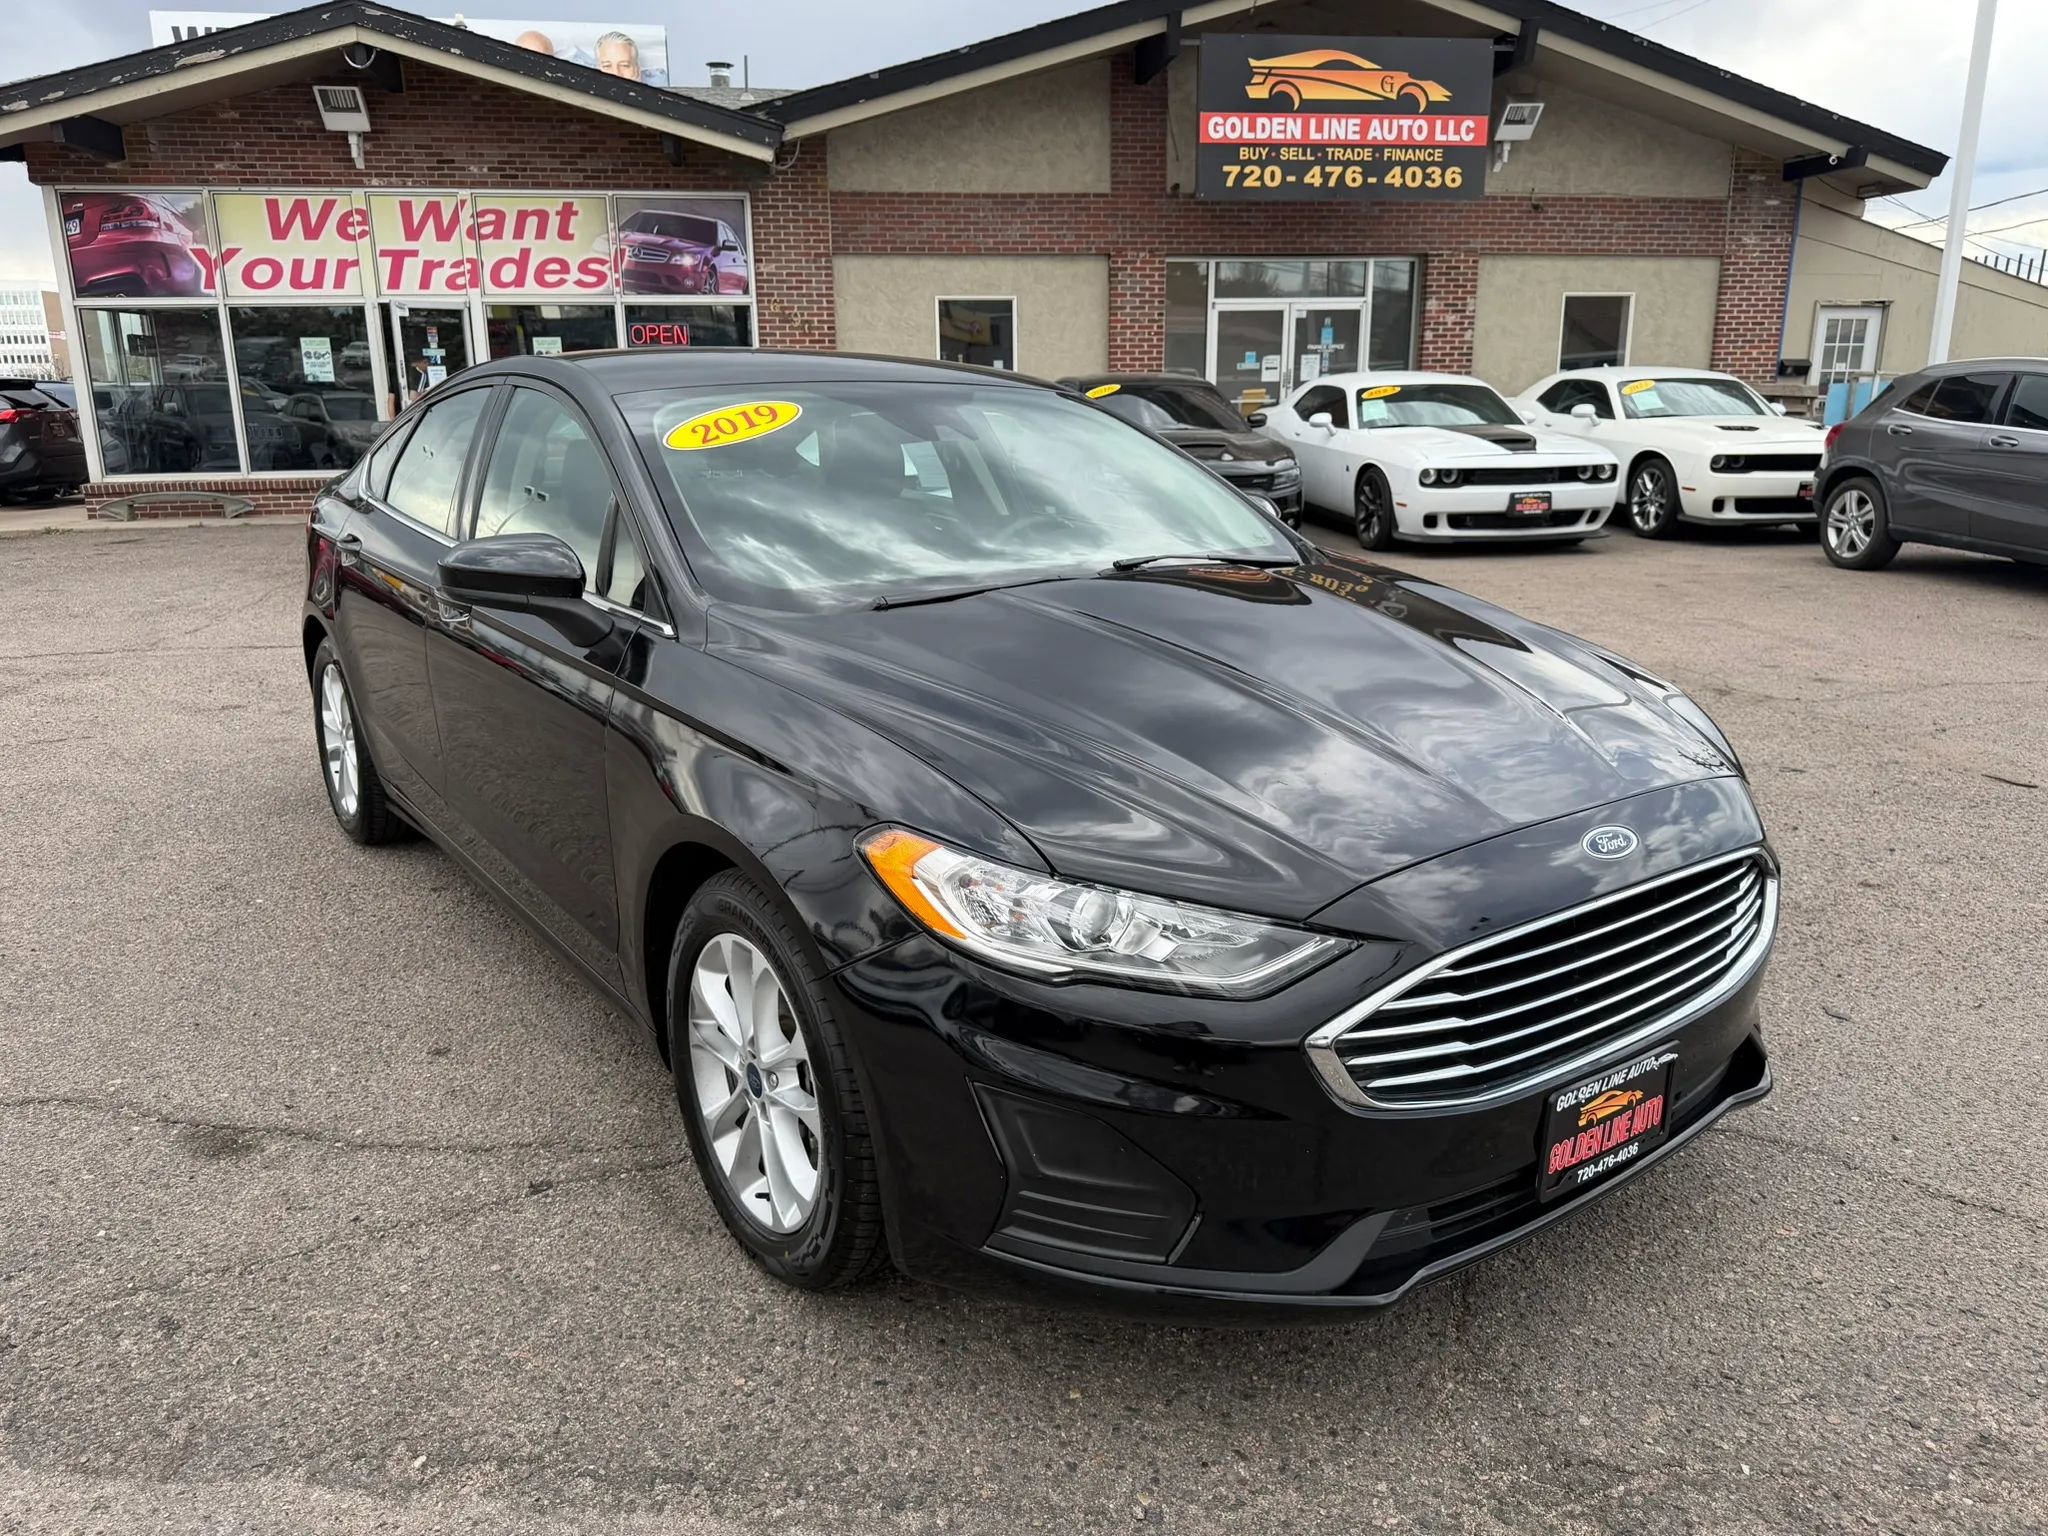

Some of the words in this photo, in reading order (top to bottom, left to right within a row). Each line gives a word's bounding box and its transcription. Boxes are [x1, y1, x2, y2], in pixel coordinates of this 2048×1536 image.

[1207, 116, 1302, 140] GOLDEN
[1309, 117, 1361, 141] LINE
[1366, 118, 1428, 142] AUTO
[1434, 119, 1476, 142] LLC
[1239, 147, 1270, 160] BUY
[1279, 147, 1315, 161] SELL
[1326, 147, 1373, 161] TRADE
[1383, 148, 1444, 162] FINANCE
[264, 198, 371, 242] We
[398, 198, 579, 242] Want
[189, 247, 360, 290] Your
[378, 247, 628, 290] Trades!
[631, 325, 689, 345] OPEN
[690, 405, 779, 445] 2019
[1595, 832, 1627, 853] Ford
[1600, 1069, 1629, 1092] LINE
[1627, 1056, 1656, 1081] AUTO
[1548, 1123, 1604, 1175] GOLDEN
[1602, 1109, 1633, 1151] LINE
[1630, 1094, 1664, 1138] AUTO
[1577, 1142, 1639, 1183] 720-476-4036
